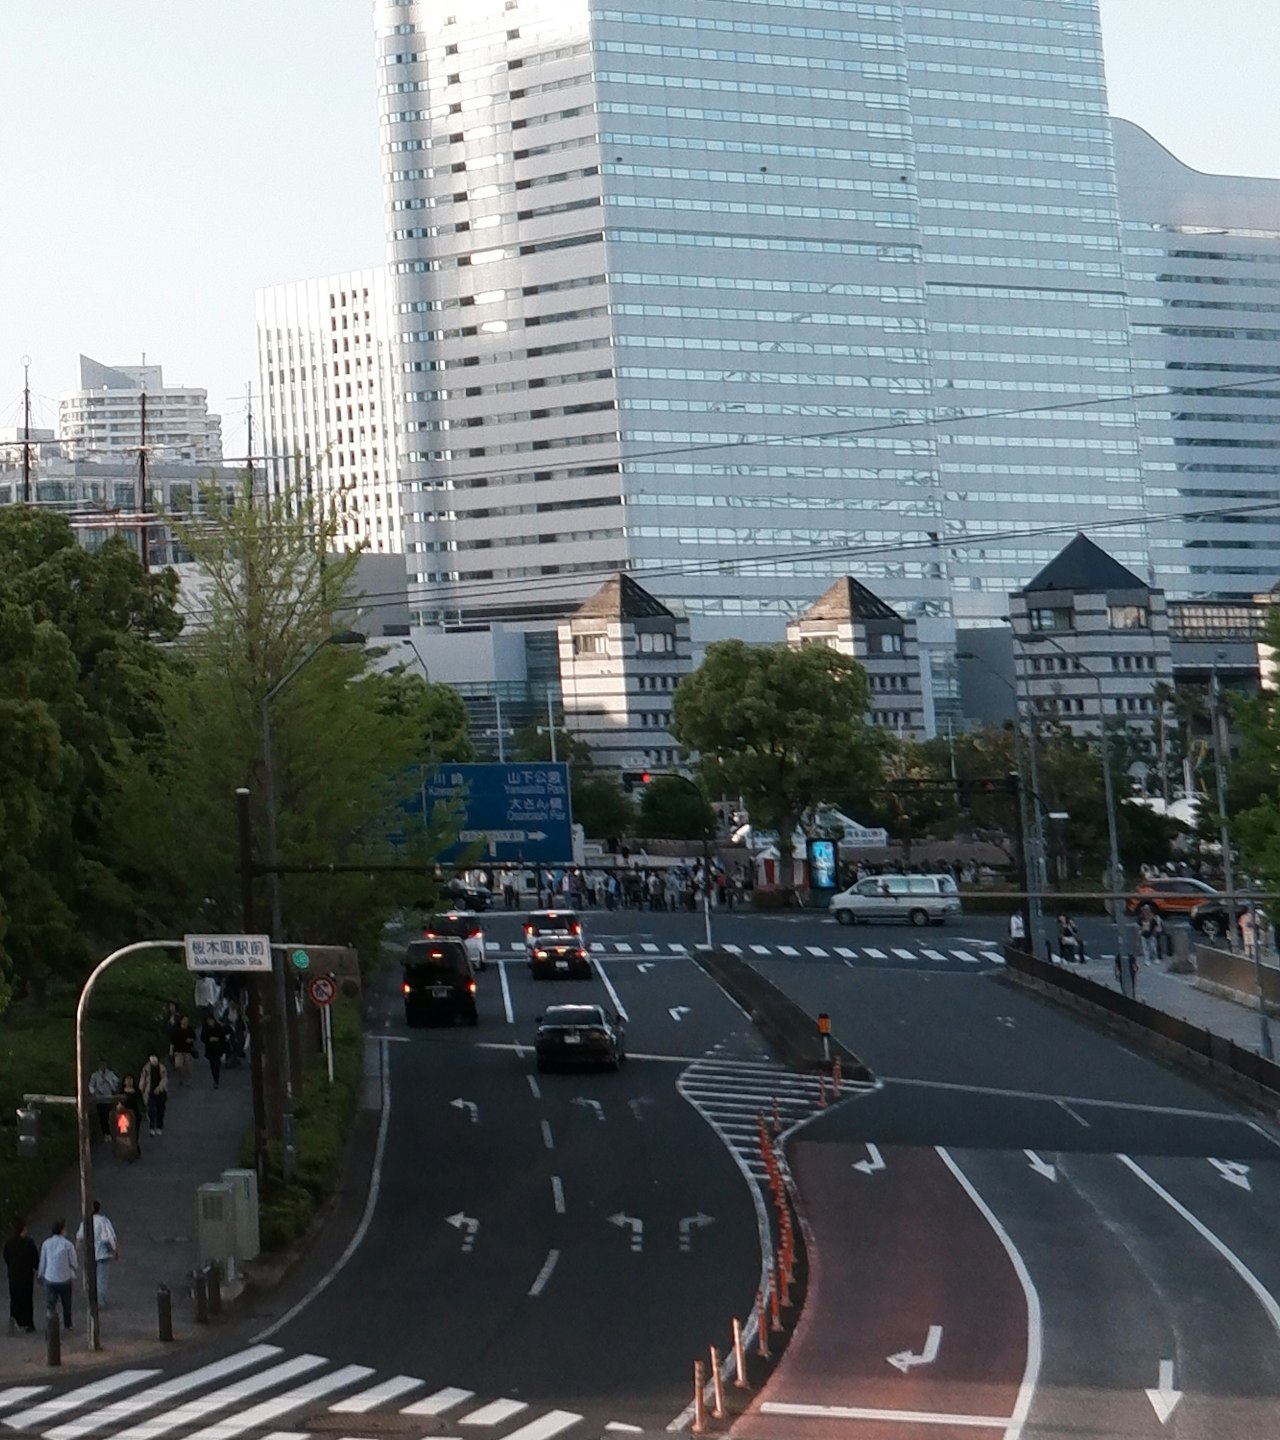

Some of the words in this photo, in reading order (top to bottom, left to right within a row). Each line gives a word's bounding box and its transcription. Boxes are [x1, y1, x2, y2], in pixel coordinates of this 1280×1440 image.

[507, 770, 561, 785] 山下公園
[192, 940, 264, 956] 桜木町駅前
[194, 956, 245, 966] Sakuragicho
